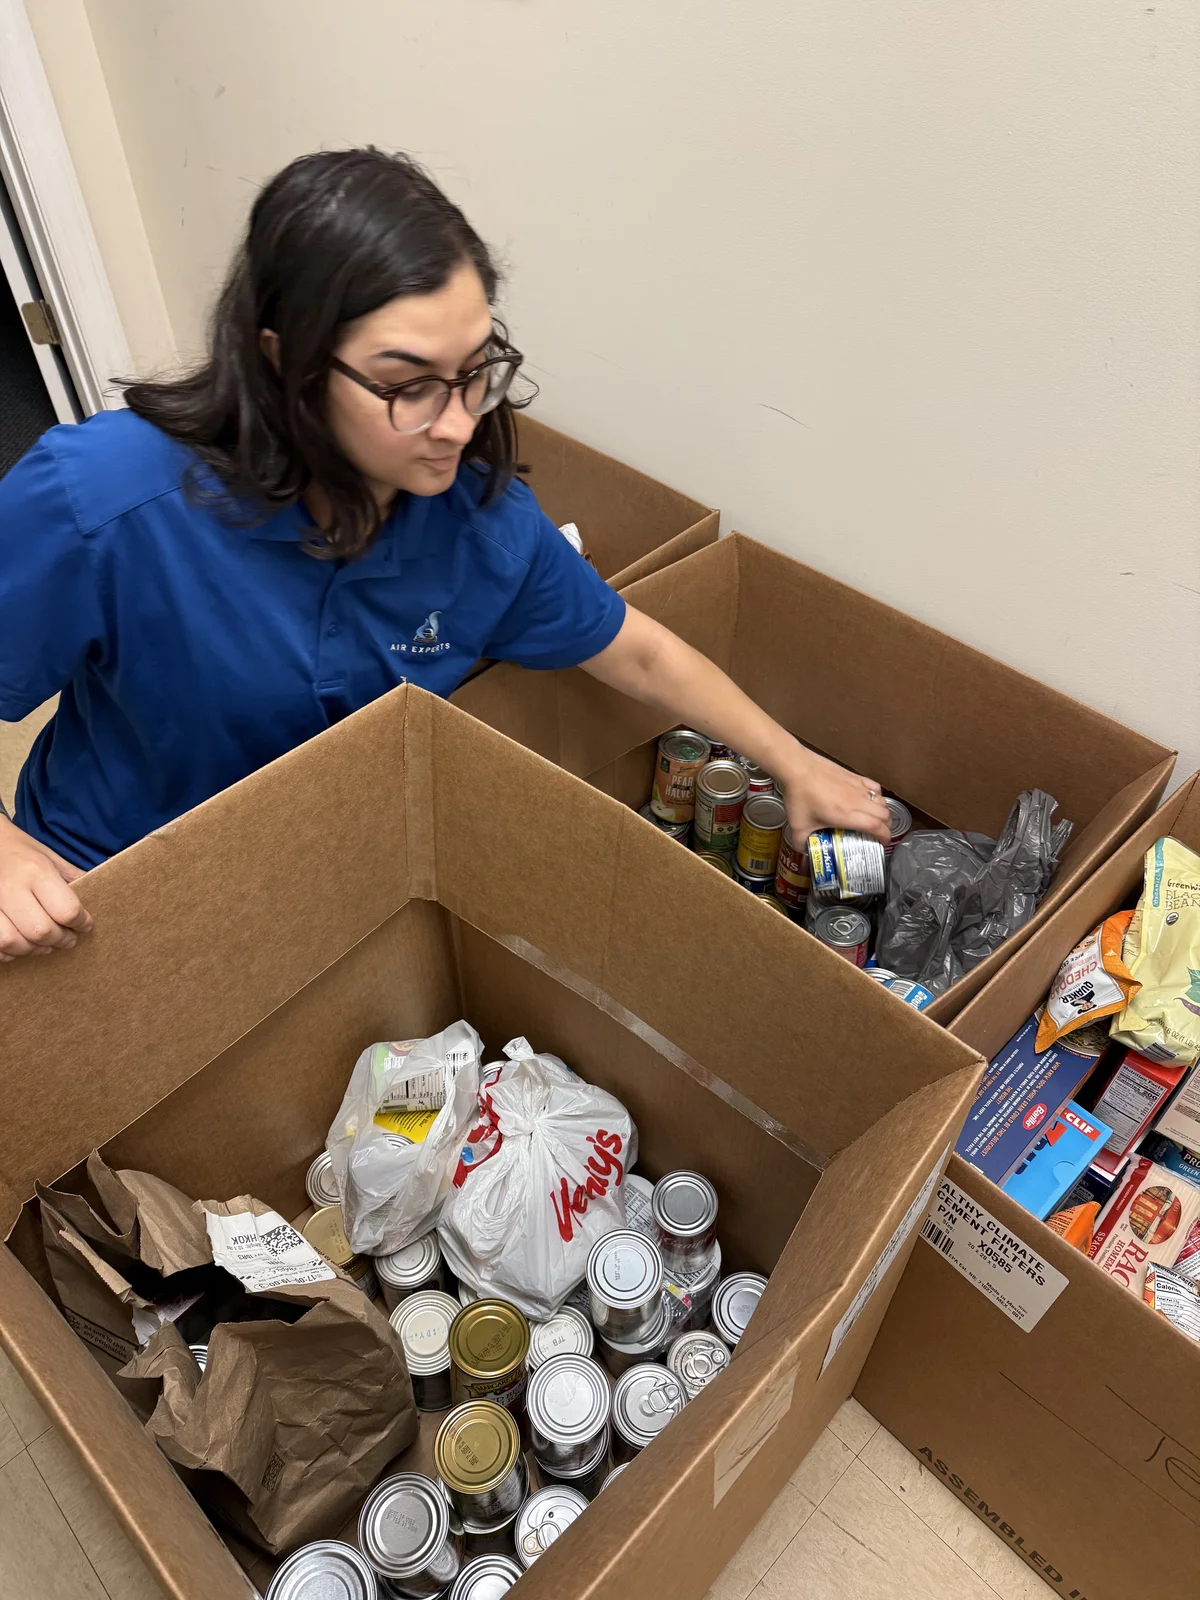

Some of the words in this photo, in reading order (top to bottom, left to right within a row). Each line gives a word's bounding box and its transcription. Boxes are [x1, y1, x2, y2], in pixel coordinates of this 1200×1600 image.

[412, 642, 451, 654] EXPERTS
[671, 775, 693, 786] PEAR
[820, 839, 833, 872] StarKist
[1048, 960, 1098, 1000] CHEDDAR
[1056, 978, 1095, 1005] QUAKER
[1170, 1030, 1180, 1039] OZ
[1016, 1099, 1028, 1112] GRAIN
[1025, 1088, 1038, 1102] WHOLE
[1007, 1110, 1020, 1123] COULD
[1024, 1104, 1045, 1128] Barilla
[1063, 1110, 1095, 1136] CLIF
[995, 1126, 1006, 1137] THIS
[979, 1135, 999, 1157] DELICIOUS?
[1177, 1162, 1199, 1176] GREEN
[230, 1232, 256, 1245] HKQK
[936, 1204, 958, 1224] P/N
[975, 1239, 1014, 1274] X0585
[984, 1219, 1045, 1273] CLIMATE
[947, 1253, 959, 1264] EPA
[989, 1236, 1046, 1286] FILTERS
[1176, 1274, 1195, 1288] Facts
[985, 1282, 1000, 1295] Made
[1005, 1299, 1025, 1317] Mexico
[92, 1328, 106, 1338] sure
[111, 1340, 127, 1351] chill
[92, 1336, 128, 1358] perishables
[918, 1446, 1064, 1583] ASSEMBLED
